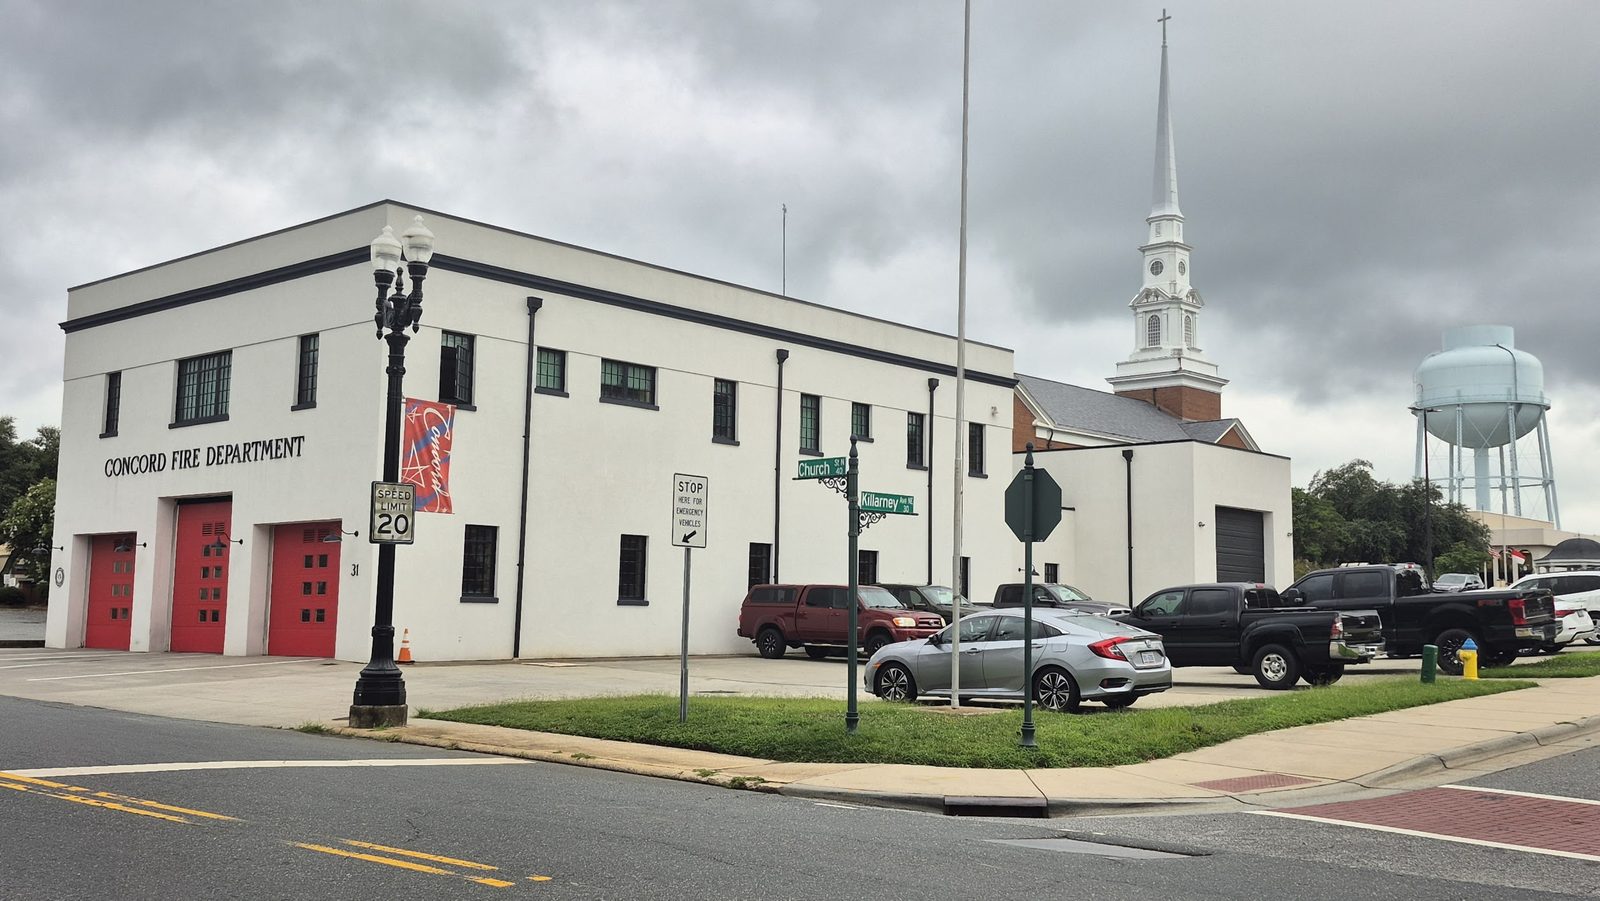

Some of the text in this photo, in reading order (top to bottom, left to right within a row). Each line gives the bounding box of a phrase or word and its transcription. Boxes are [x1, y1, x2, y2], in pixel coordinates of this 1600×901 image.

[104, 436, 305, 477] CONCORD FIRE DEPARTMENT
[423, 404, 453, 510] Concord
[798, 462, 830, 477] Church
[377, 489, 411, 500] SPEED
[678, 481, 703, 494] STOP
[381, 502, 407, 511] LIMIT
[861, 493, 898, 511] Killarney
[676, 507, 703, 516] EMERGENCY
[377, 513, 409, 535] 20
[679, 519, 701, 527] VEHICLES
[350, 563, 359, 577] 31
